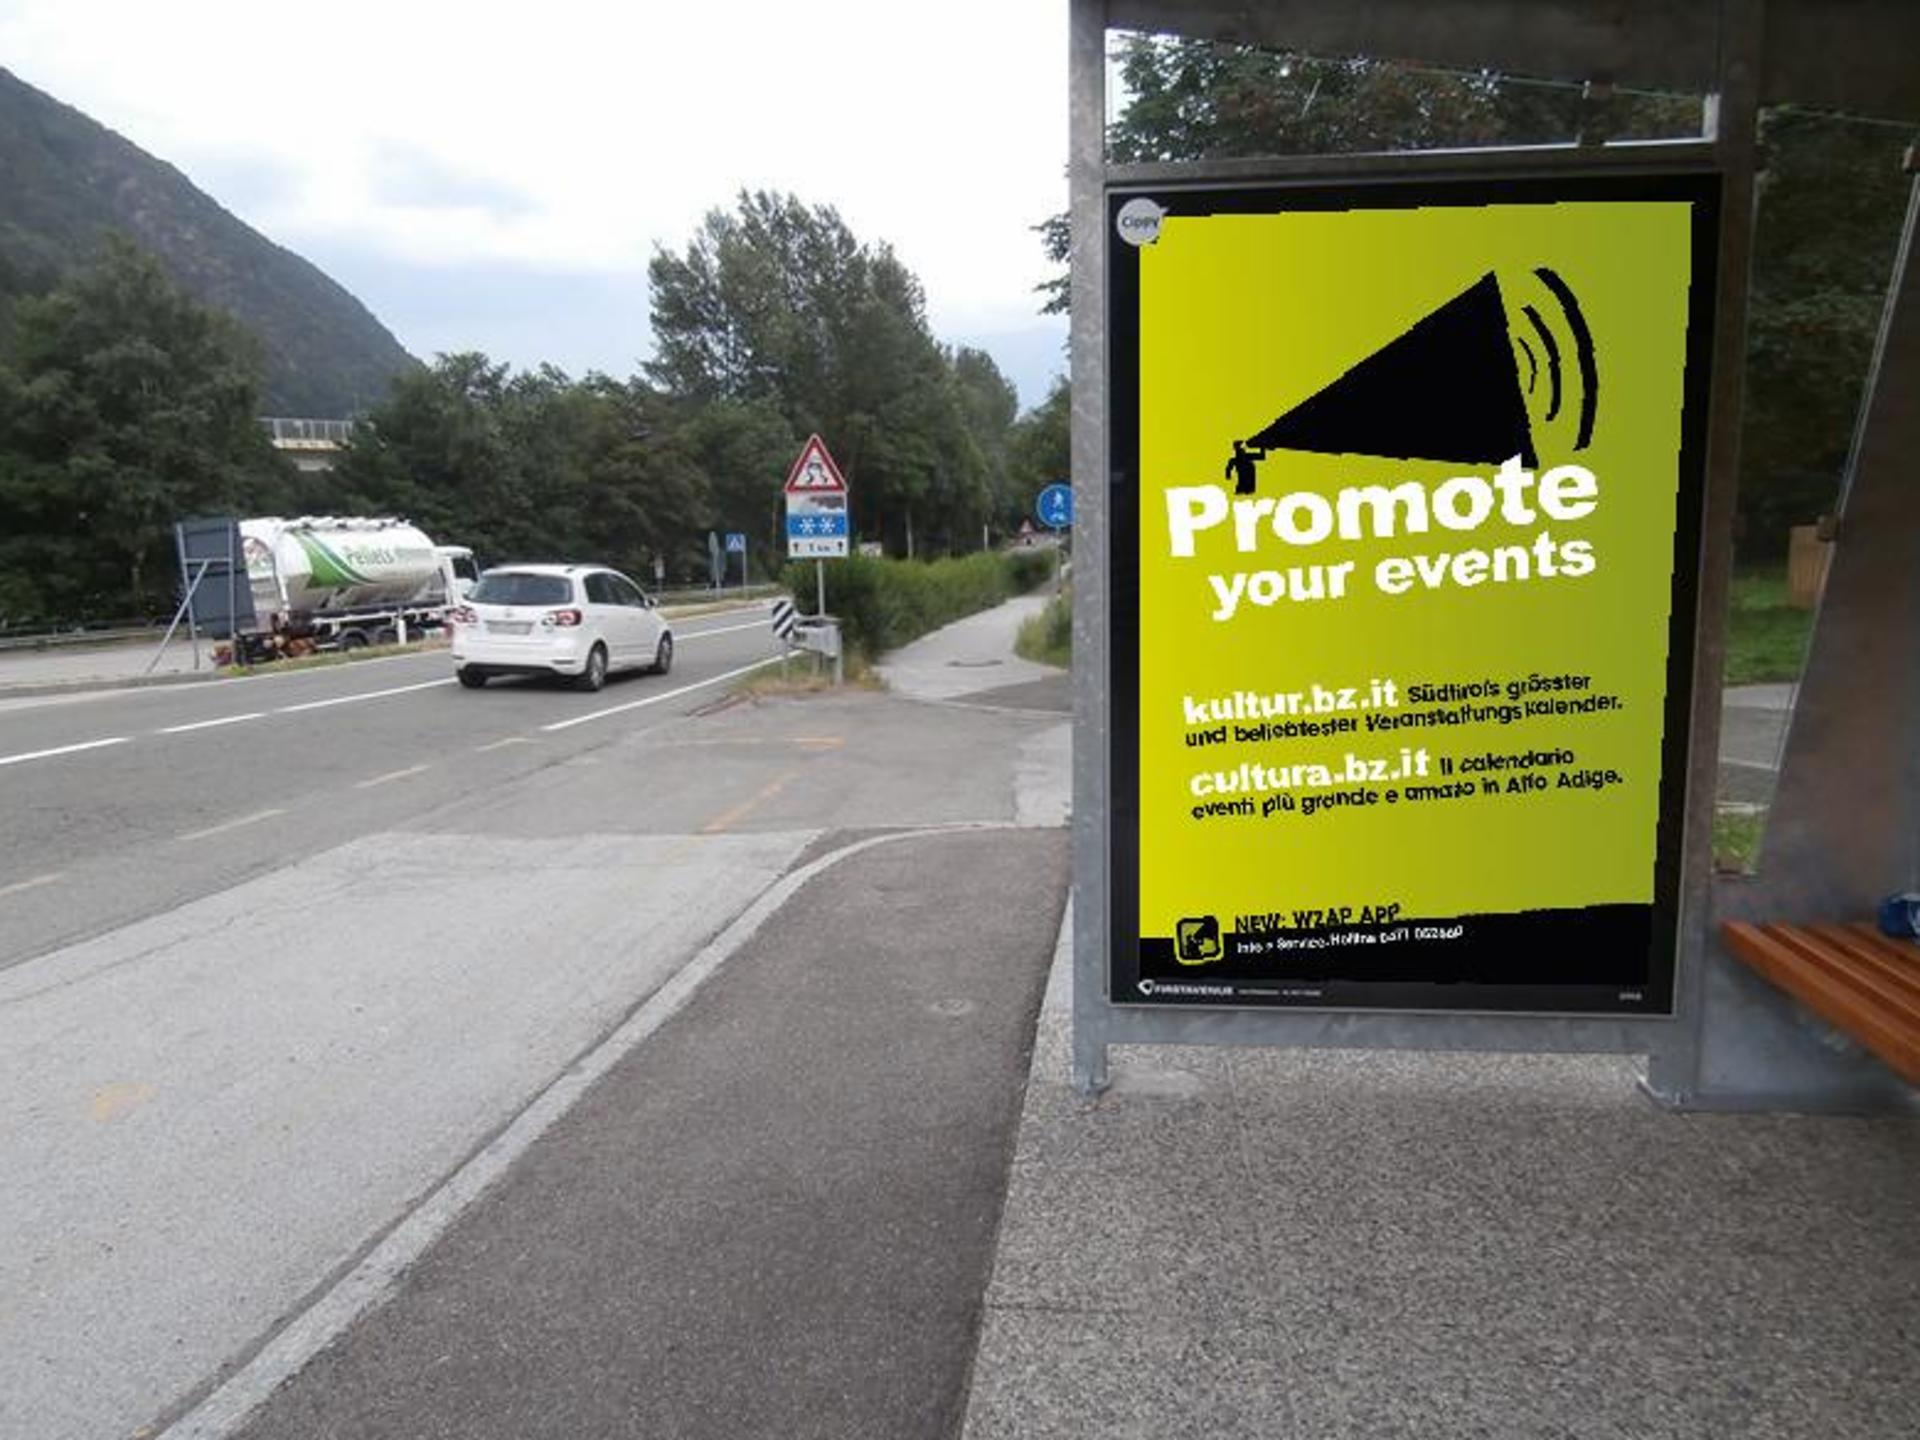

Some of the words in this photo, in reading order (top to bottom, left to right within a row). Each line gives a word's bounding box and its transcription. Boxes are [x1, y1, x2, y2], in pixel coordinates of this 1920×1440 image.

[1164, 453, 1599, 557] Promote
[1208, 561, 1354, 621] your
[1375, 532, 1597, 594] events
[1183, 678, 1399, 724] kultur.bz.it
[1506, 674, 1592, 702] grösster
[1185, 725, 1227, 747] und
[1234, 717, 1358, 742] beliebtester
[1189, 747, 1431, 797] cultura.bz.it
[1459, 747, 1575, 774] calendario
[1190, 796, 1255, 820] eventi
[1262, 792, 1295, 817] più
[1301, 787, 1379, 815] grande
[1385, 789, 1399, 804] e
[1404, 781, 1475, 801] amato
[1481, 776, 1500, 795] in
[1506, 774, 1548, 795] Alto
[1557, 769, 1624, 791] Adige.
[1235, 911, 1286, 934] NEW:
[1360, 902, 1401, 924] APP
